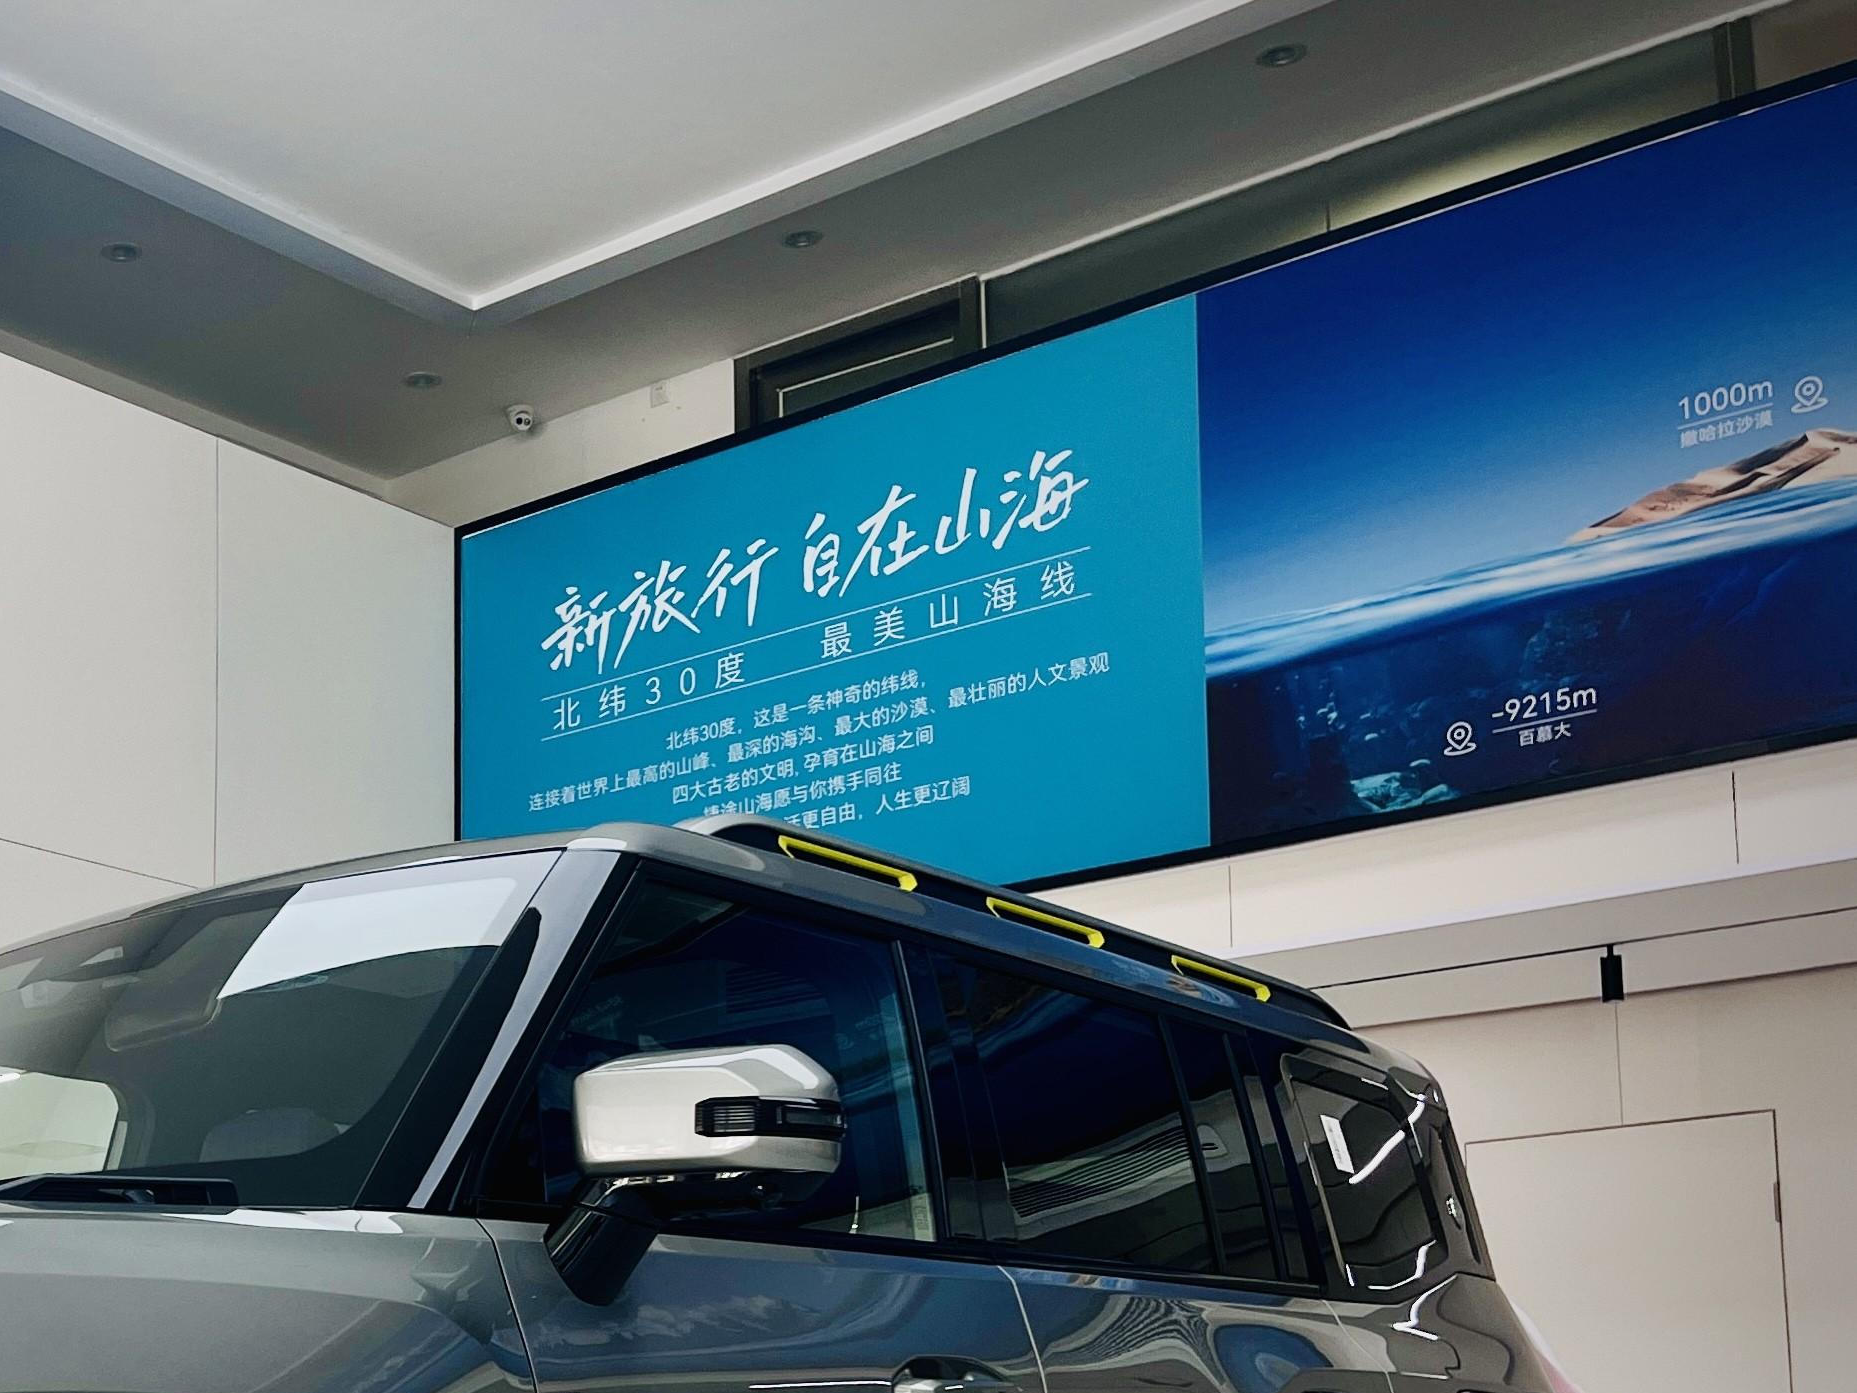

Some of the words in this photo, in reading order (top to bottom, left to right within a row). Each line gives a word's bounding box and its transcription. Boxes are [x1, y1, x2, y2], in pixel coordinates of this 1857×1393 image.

[1678, 380, 1773, 420] 1000m
[541, 538, 779, 675] 新旅行
[803, 449, 1090, 598] 自在山海
[552, 652, 746, 732] 北纬30度
[820, 560, 1076, 659] 最美山海线
[1492, 687, 1597, 722] -9215m
[1518, 721, 1572, 747] 百慕大
